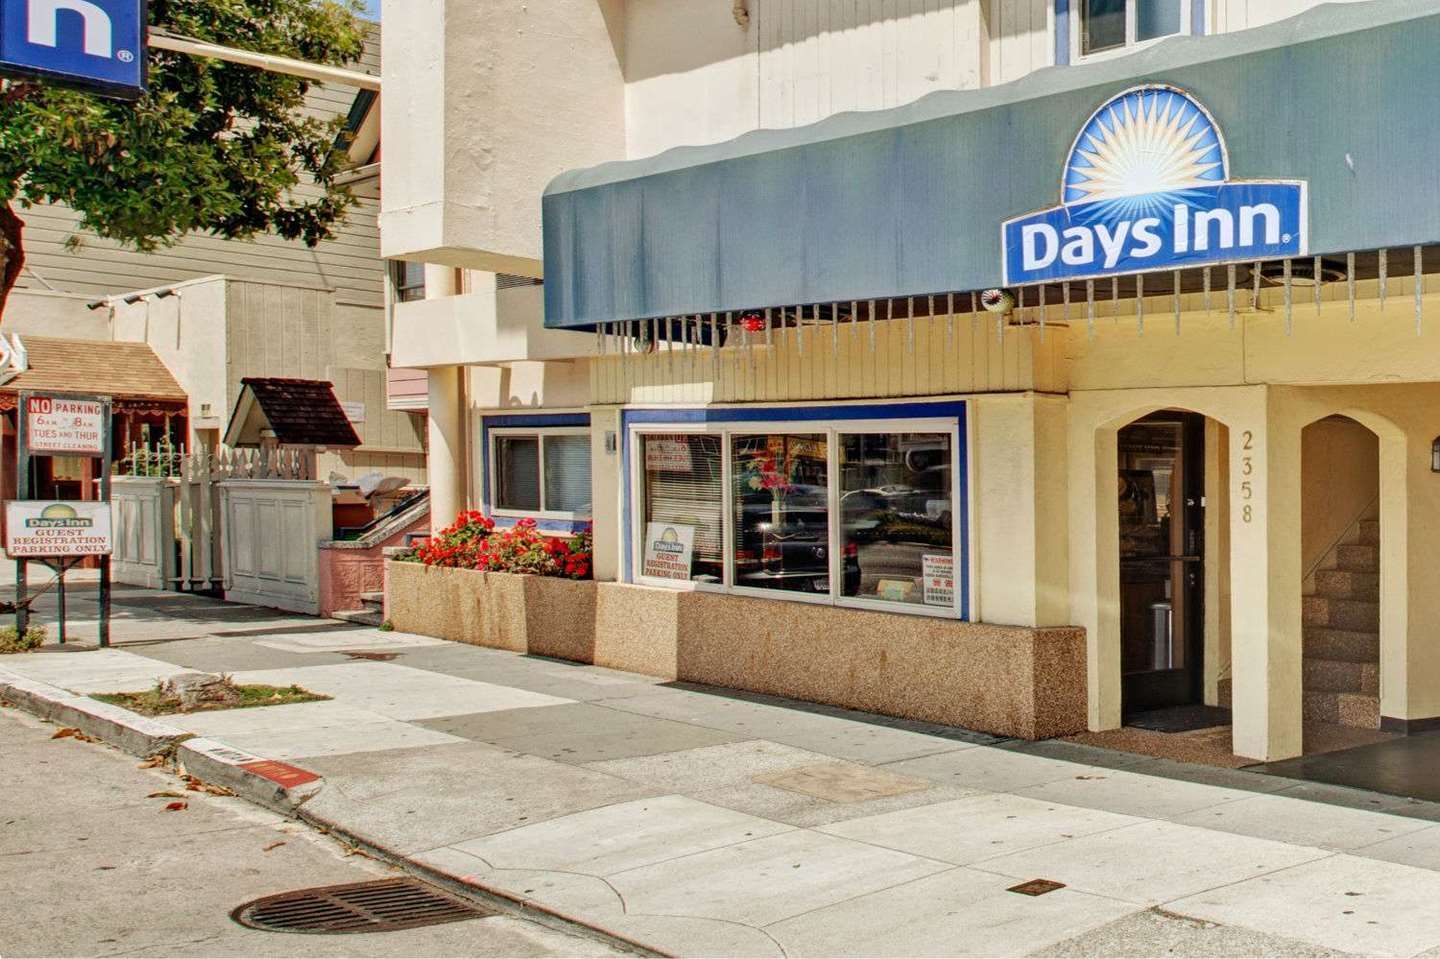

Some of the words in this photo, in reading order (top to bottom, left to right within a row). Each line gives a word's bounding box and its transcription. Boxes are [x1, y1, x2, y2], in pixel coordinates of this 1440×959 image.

[1022, 217, 1162, 271] Days
[1173, 203, 1280, 254] Inn
[30, 399, 51, 413] NO
[55, 403, 101, 416] PARKING
[33, 430, 57, 438] TUES
[74, 431, 98, 440] THUR
[1241, 430, 1253, 523] 2358
[14, 537, 106, 545] REGISTRATION
[13, 545, 70, 553] PARKING
[75, 544, 107, 553] ONLY
